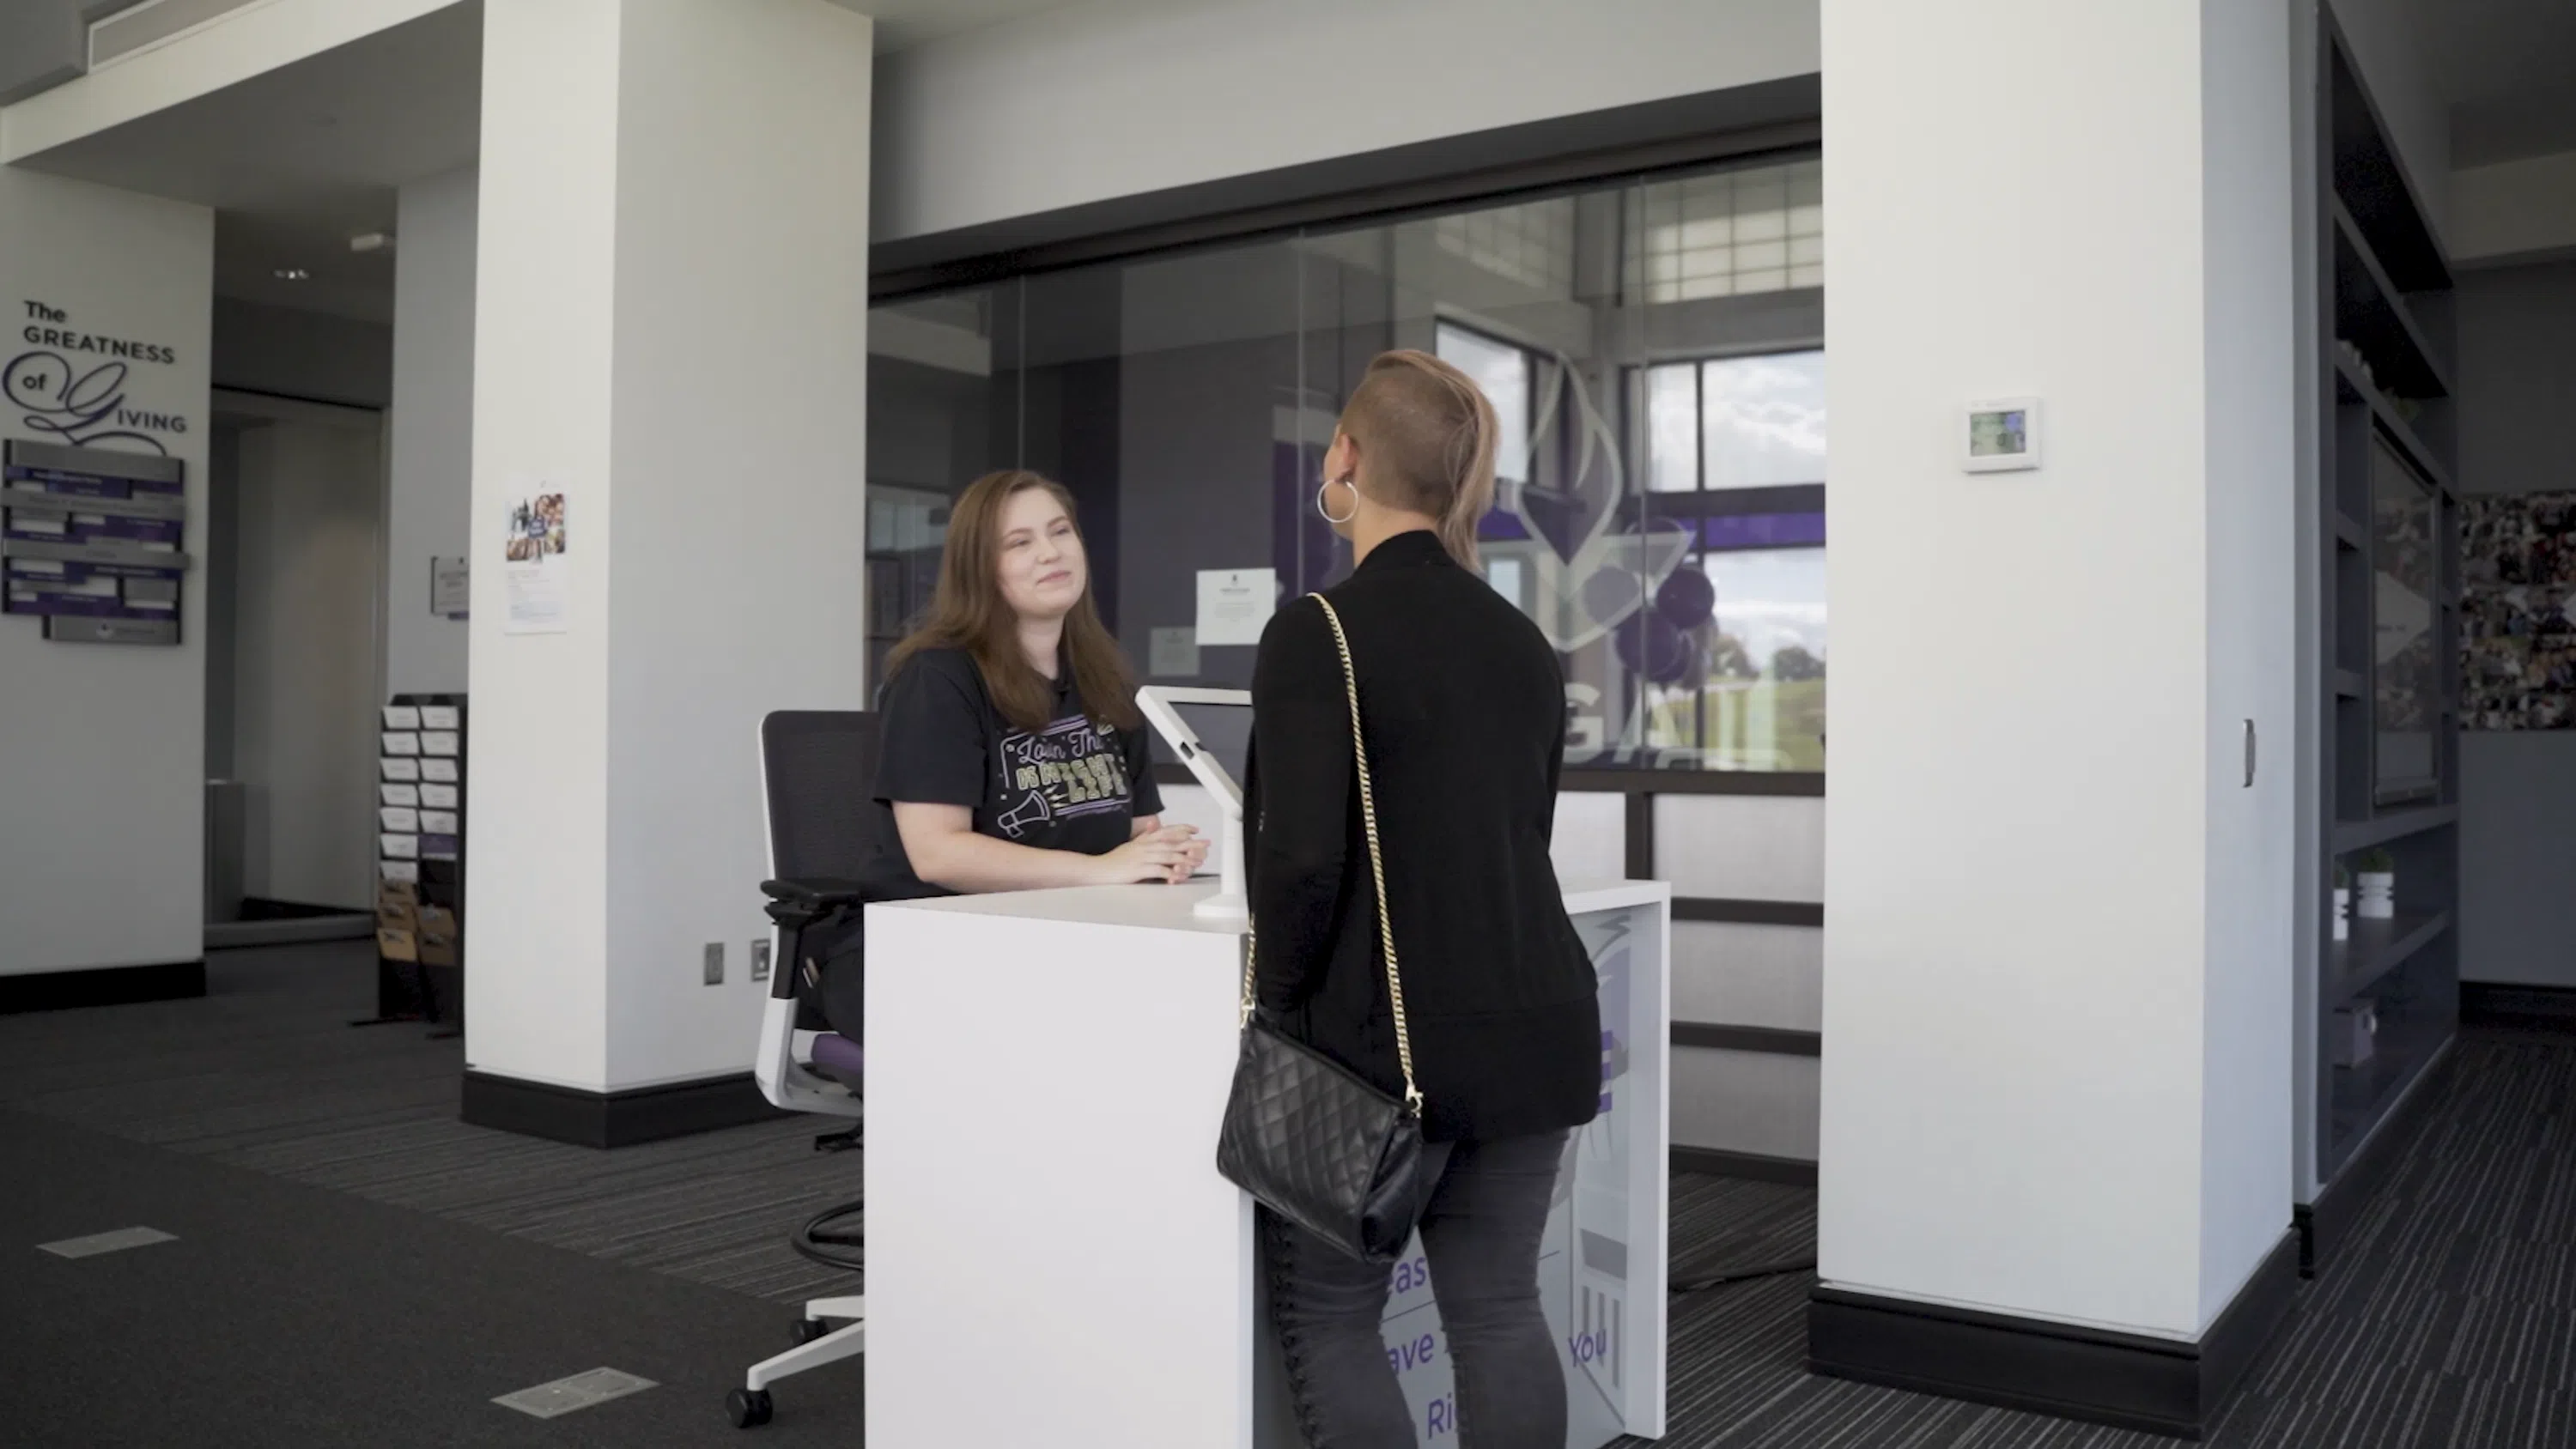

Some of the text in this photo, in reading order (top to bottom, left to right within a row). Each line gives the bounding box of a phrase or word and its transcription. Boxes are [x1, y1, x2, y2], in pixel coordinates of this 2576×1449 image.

[24, 300, 67, 324] The
[23, 325, 176, 365] GREATNESS
[22, 373, 48, 391] of
[1389, 1256, 1427, 1294] as
[1427, 1392, 1455, 1440] Ri
